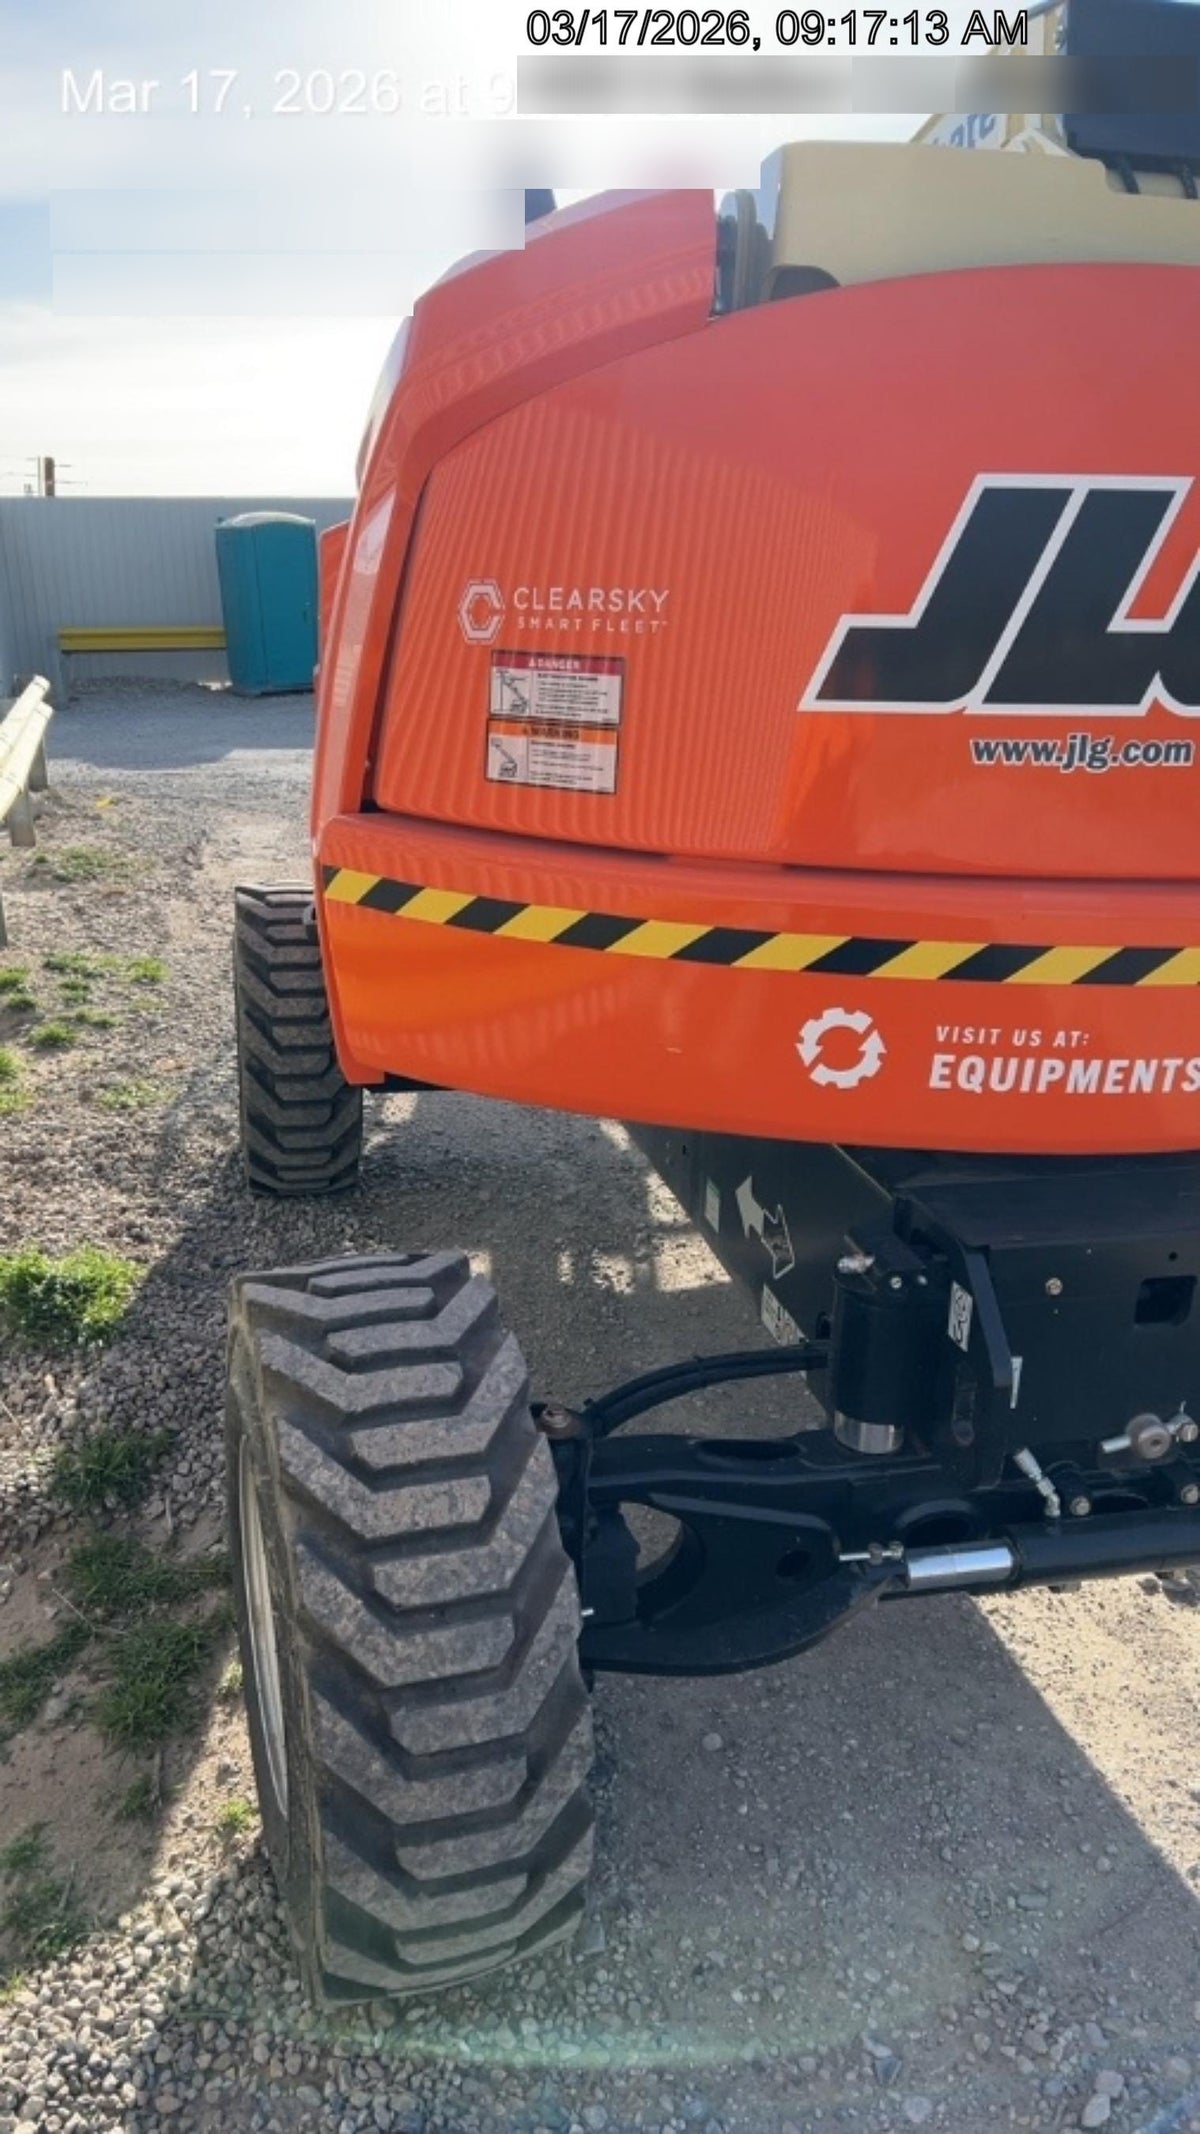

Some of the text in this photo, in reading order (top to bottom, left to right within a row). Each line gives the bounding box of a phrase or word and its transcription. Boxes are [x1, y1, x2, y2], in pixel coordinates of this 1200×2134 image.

[513, 586, 670, 613] CLEARSKY
[517, 615, 583, 632] SMART
[969, 732, 1193, 772] www.jlg.com
[936, 1025, 1090, 1048] VISIT US AT:
